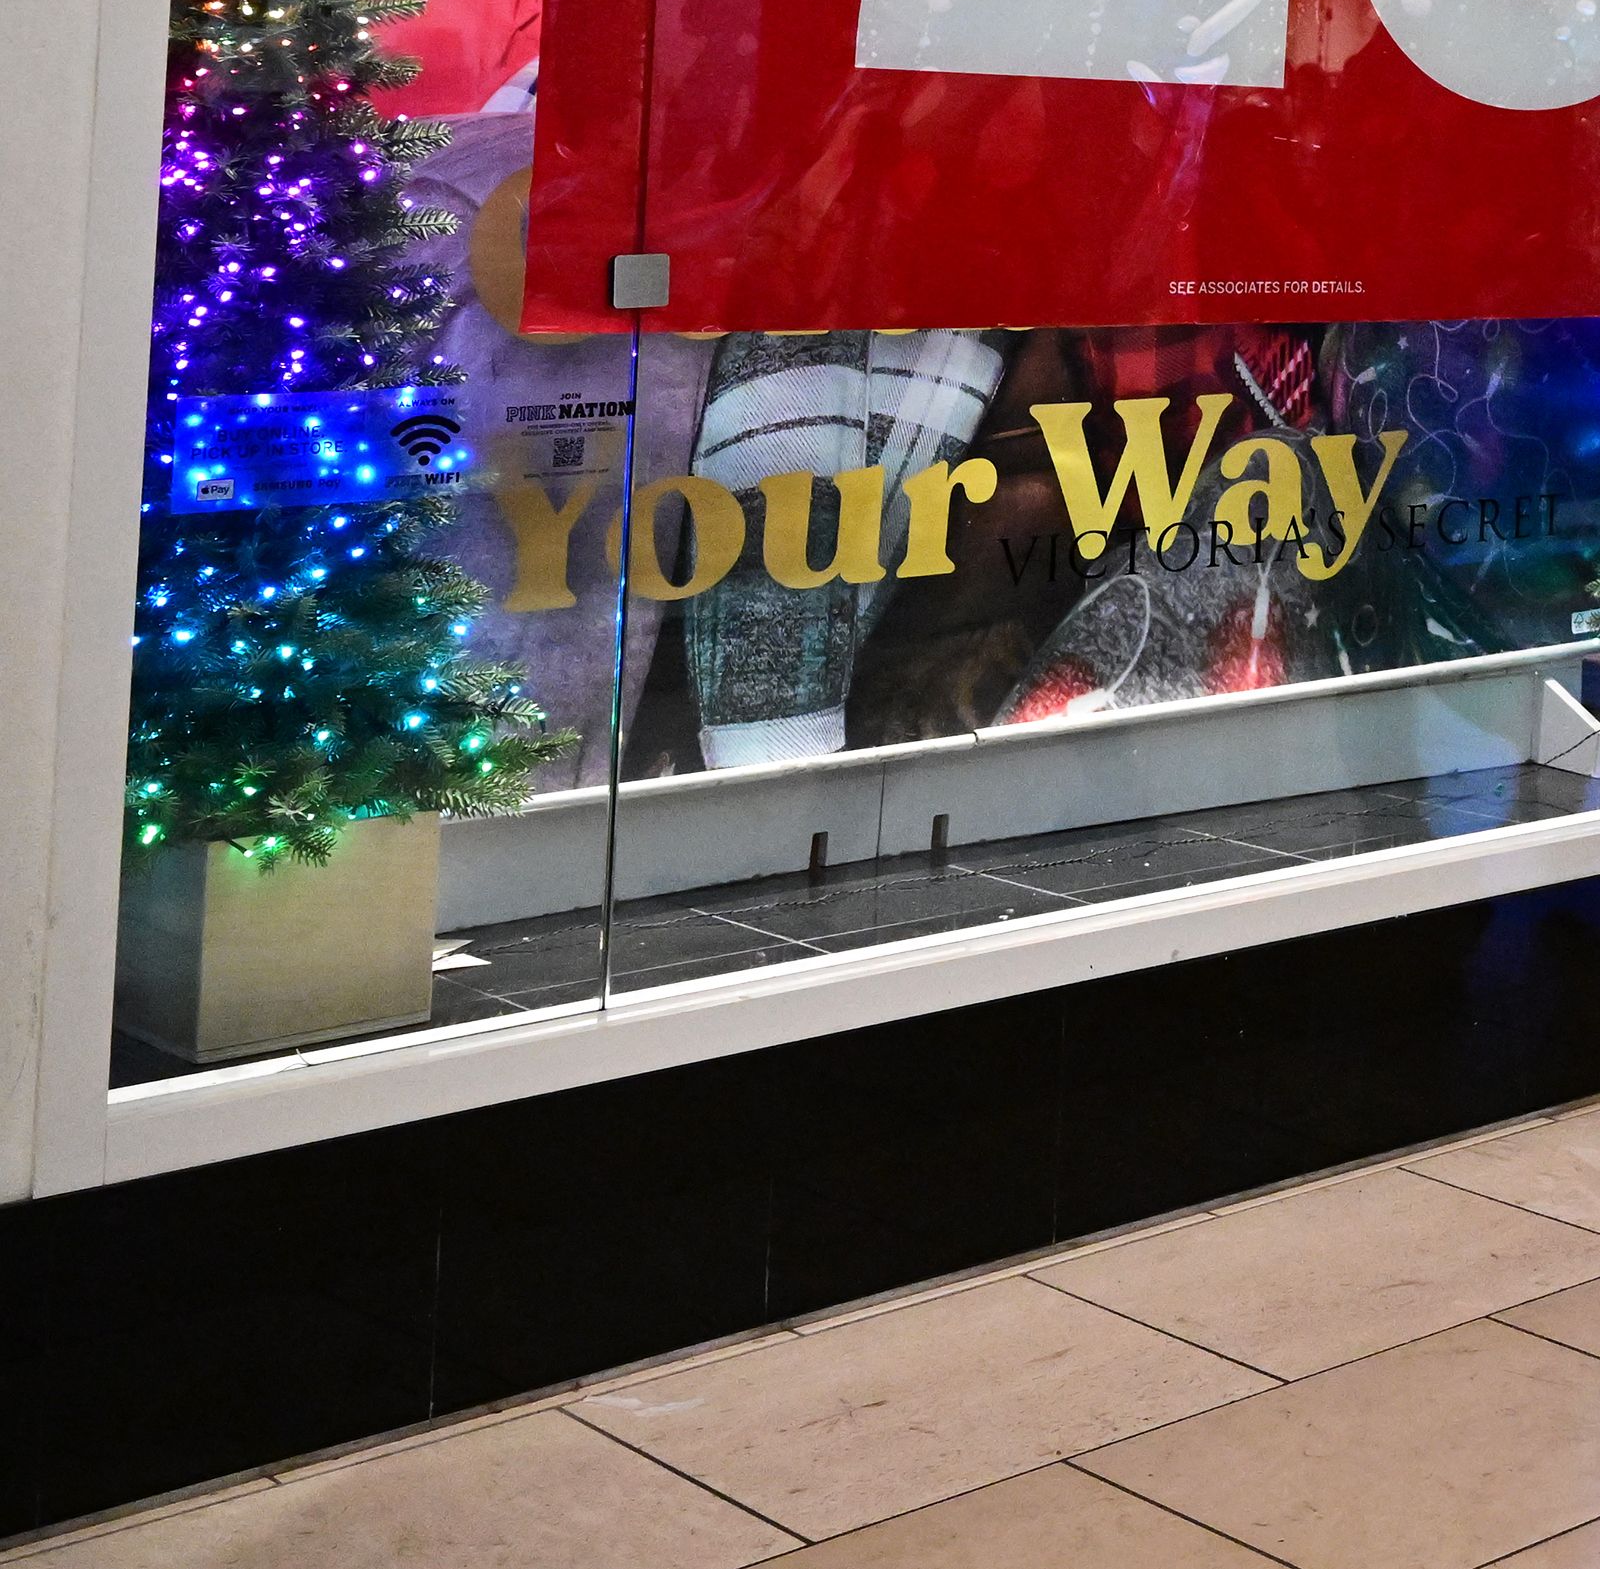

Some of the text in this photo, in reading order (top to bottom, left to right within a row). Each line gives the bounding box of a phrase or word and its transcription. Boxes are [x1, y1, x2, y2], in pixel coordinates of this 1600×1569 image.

[1169, 280, 1366, 294] SEE ASSOCIATES FOR DETAILS.
[440, 398, 456, 407] ON
[506, 401, 635, 422] PINK NATION
[218, 428, 253, 443] BUY
[191, 447, 230, 460] PICK
[236, 445, 258, 459] UP
[266, 444, 284, 457] IN
[253, 477, 341, 492] SAMSUNG Pay
[424, 472, 460, 486] WIFI
[210, 484, 229, 496] Pay
[495, 394, 1408, 612] Your Way
[999, 492, 1562, 587] VICTORIA'S SECRET
